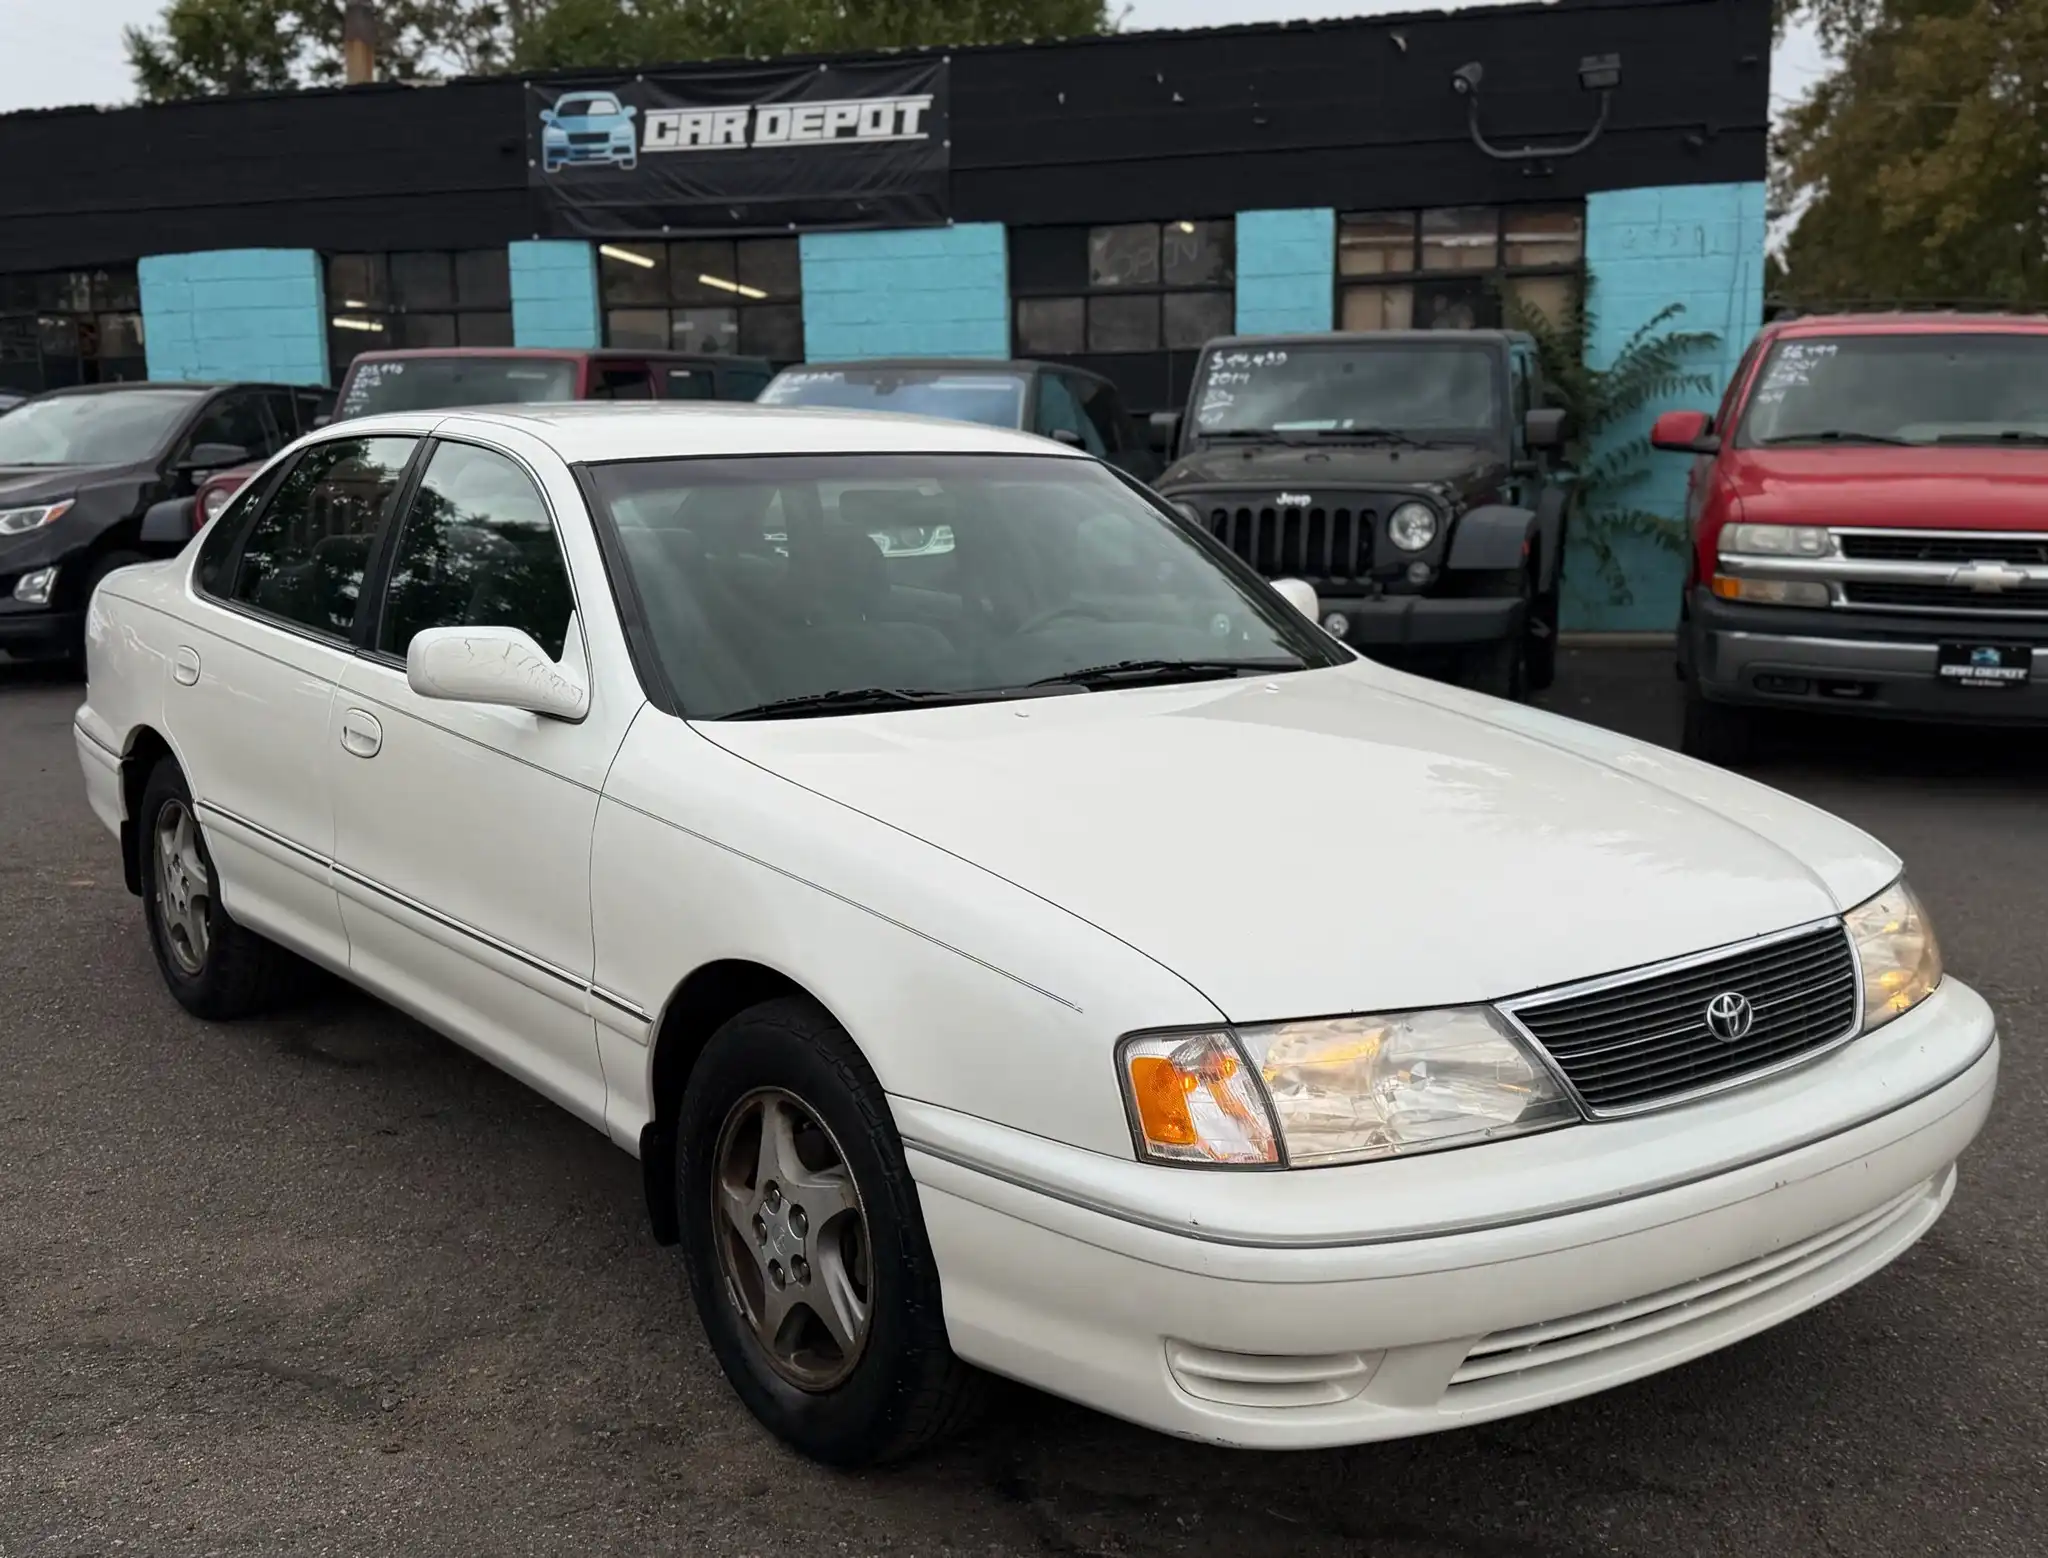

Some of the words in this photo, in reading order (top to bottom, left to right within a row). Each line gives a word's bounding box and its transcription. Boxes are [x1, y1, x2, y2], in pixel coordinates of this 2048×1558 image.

[640, 105, 752, 153] CAR
[751, 95, 934, 149] DEPOT
[1276, 492, 1312, 507] Jeep
